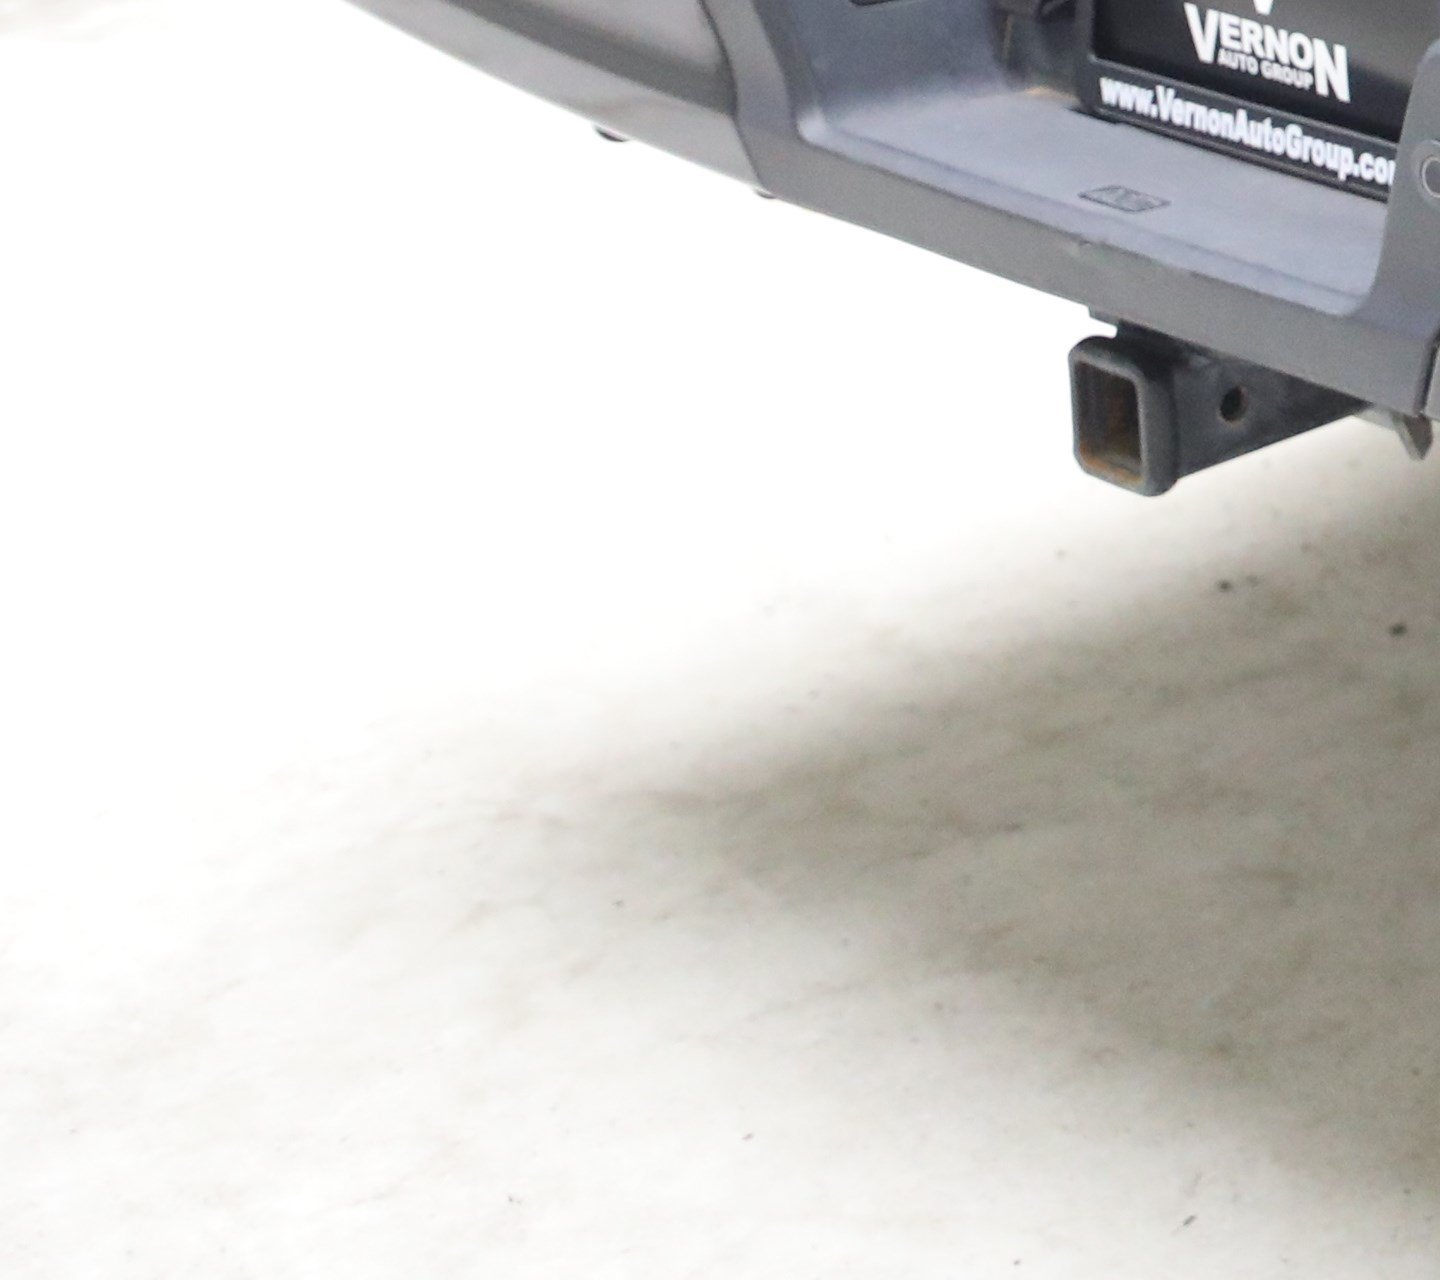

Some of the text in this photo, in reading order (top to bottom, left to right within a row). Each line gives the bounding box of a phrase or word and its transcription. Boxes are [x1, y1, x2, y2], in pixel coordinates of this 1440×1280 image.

[1183, 2, 1352, 103] VERNON
[1217, 48, 1314, 91] AUTO GROUP
